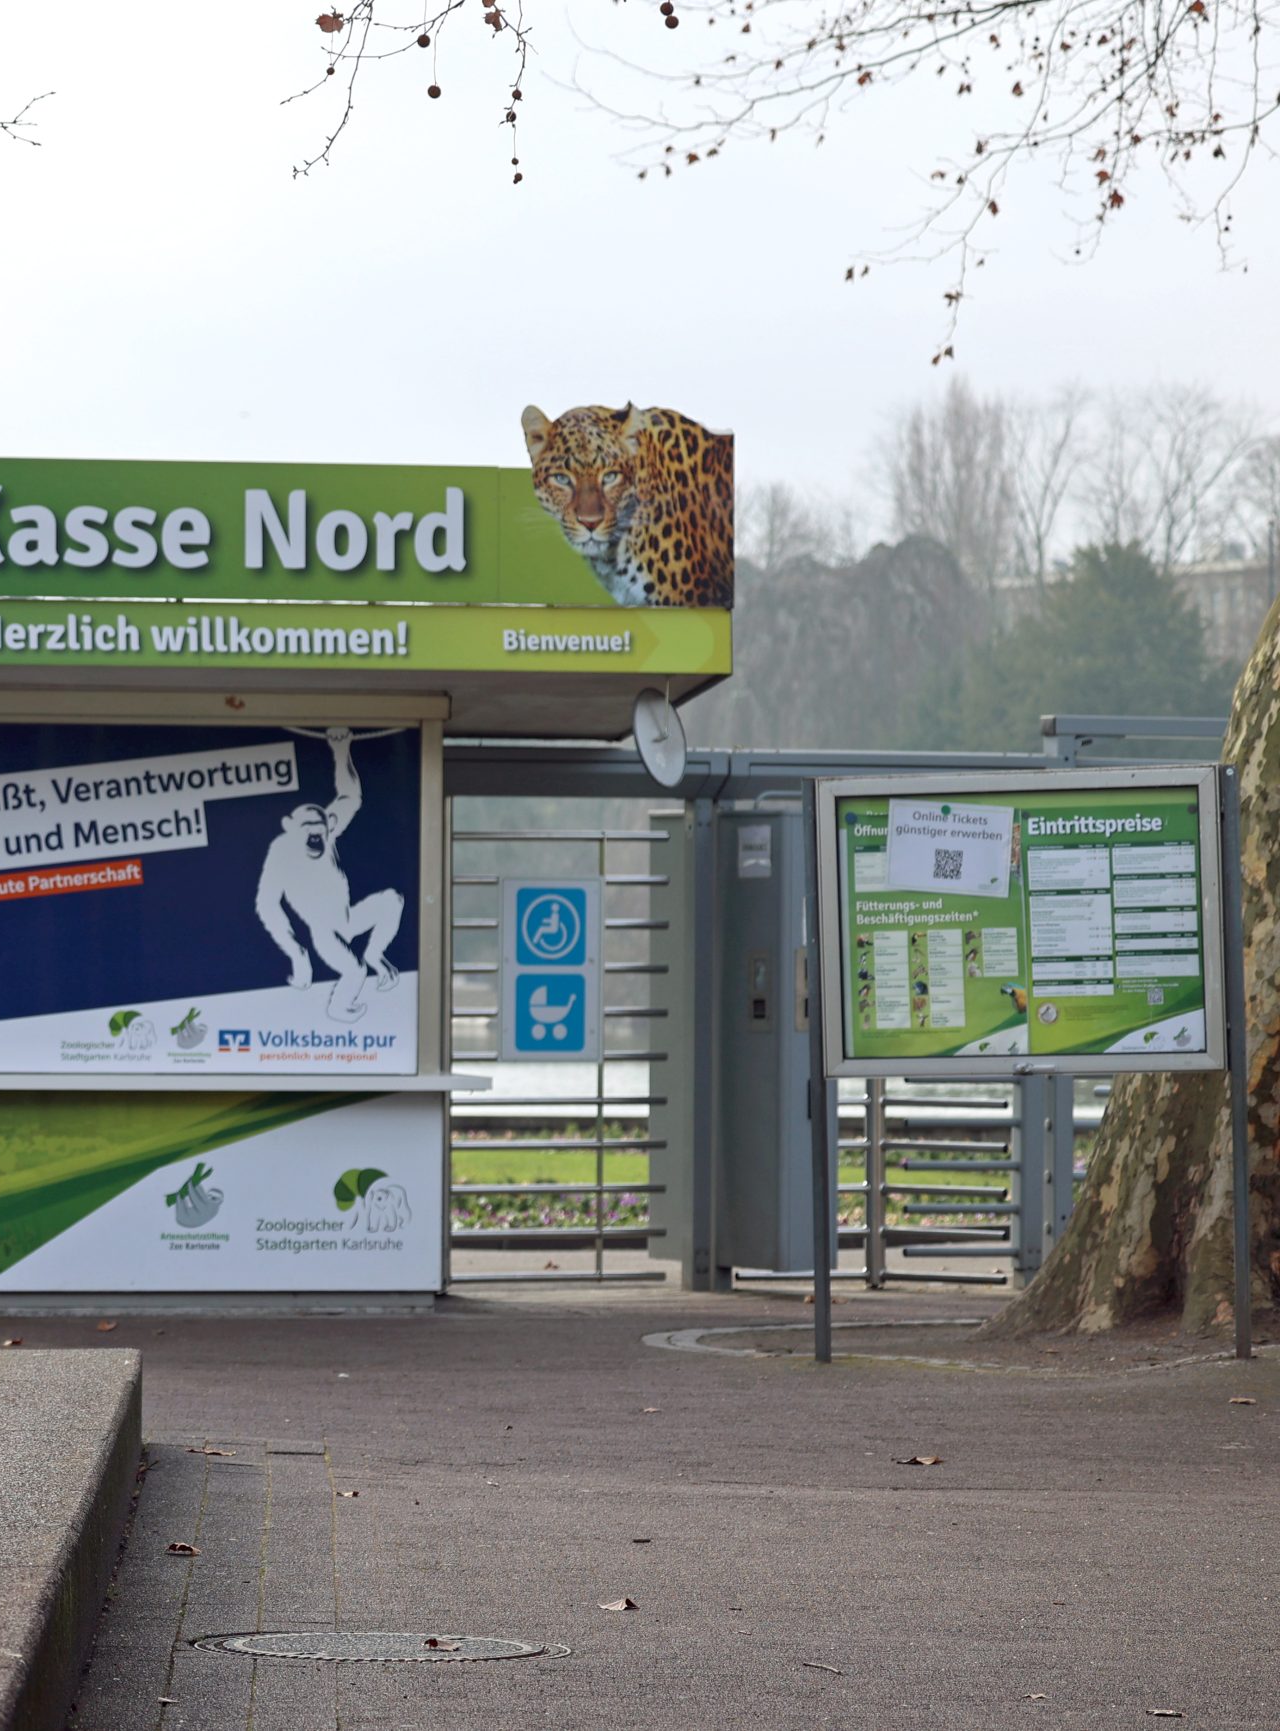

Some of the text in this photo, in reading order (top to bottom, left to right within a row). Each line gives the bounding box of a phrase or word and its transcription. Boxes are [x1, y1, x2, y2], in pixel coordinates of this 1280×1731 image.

[244, 486, 467, 573] Nord
[150, 616, 409, 656] willkommen!
[502, 629, 632, 652] Bienvenue!
[51, 757, 294, 804] Verantwortung
[912, 811, 988, 825] Online Tickets
[1027, 813, 1163, 838] Eintrittspreise
[4, 823, 64, 856] und
[74, 808, 204, 849] Mensch!
[896, 825, 1003, 841] günstiger erwerben
[27, 862, 141, 892] Partnerschaft
[856, 898, 943, 913] Fütterungs- und
[258, 1030, 397, 1051] Volksbank pur
[60, 1052, 112, 1063] Stadtgarten
[259, 1051, 378, 1063] persönlich und regional
[256, 1219, 345, 1236] Zoologischer
[256, 1237, 403, 1254] Stadtgarten Karlsruhe
